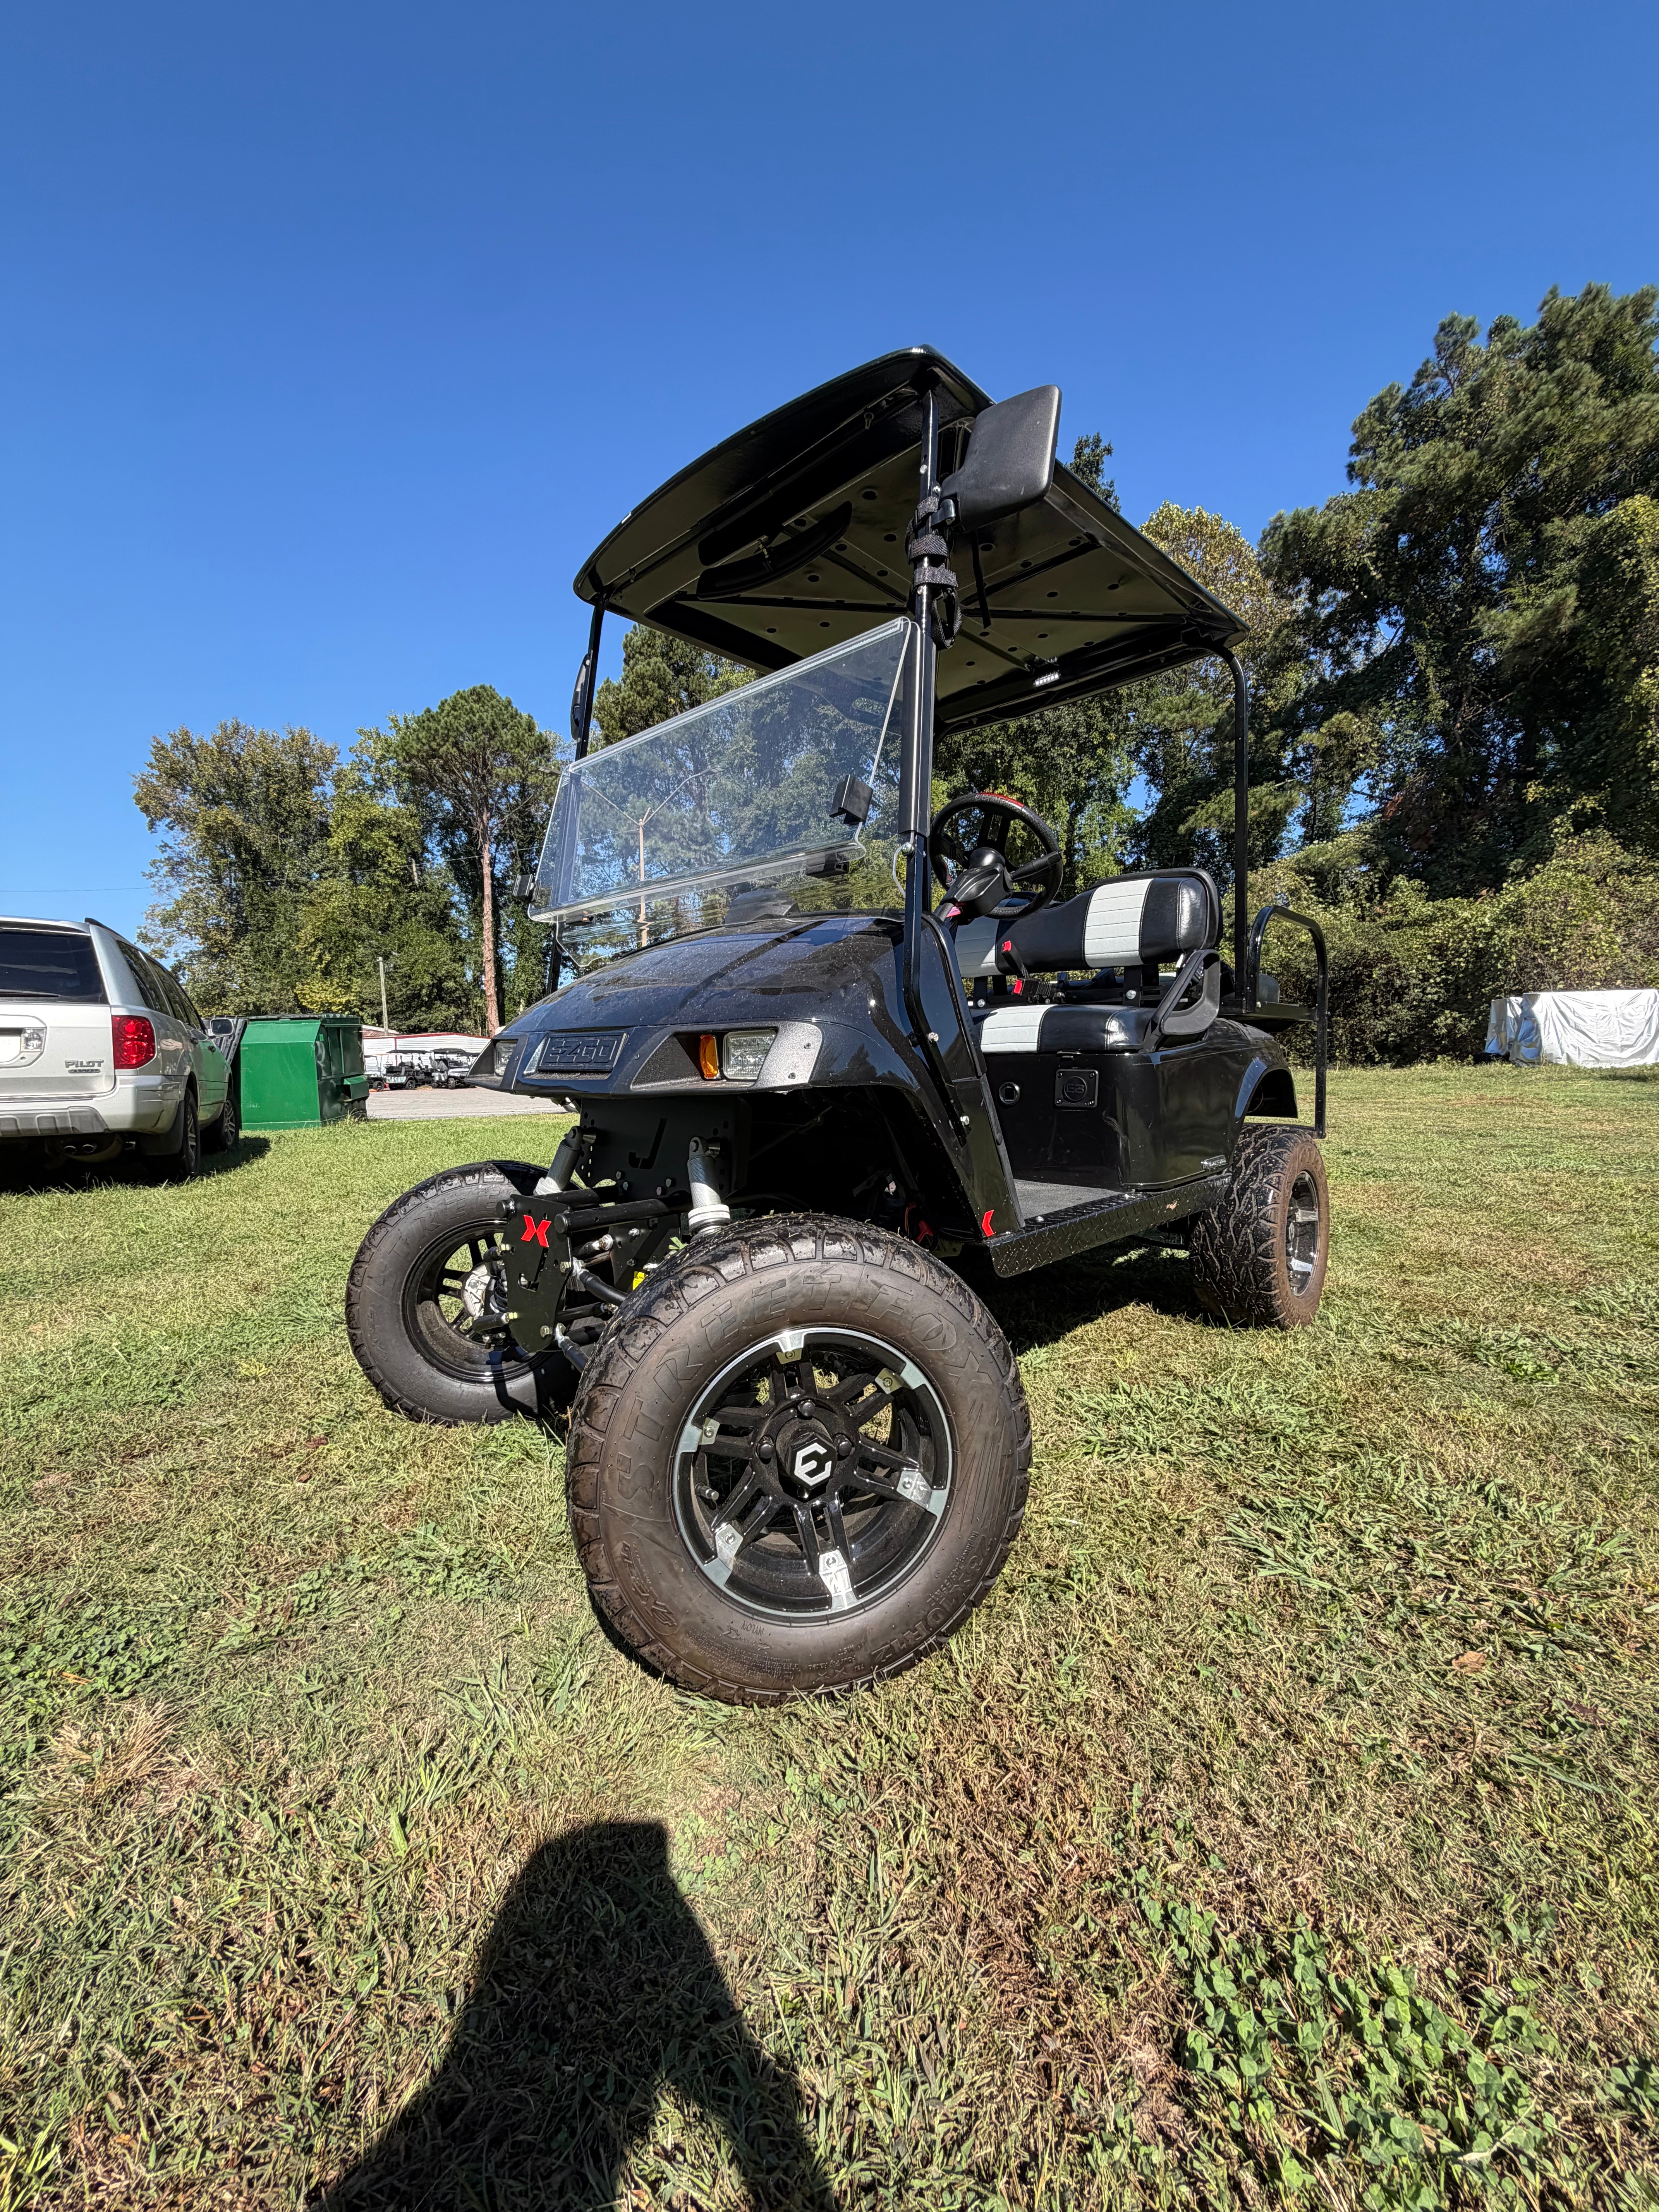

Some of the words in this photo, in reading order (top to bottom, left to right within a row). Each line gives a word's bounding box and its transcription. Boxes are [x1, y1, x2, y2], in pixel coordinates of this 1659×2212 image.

[64, 1059, 104, 1068] PILOT
[618, 1274, 842, 1501] STREET
[864, 1283, 995, 1386] FOX
[741, 1620, 764, 1636] NYLON
